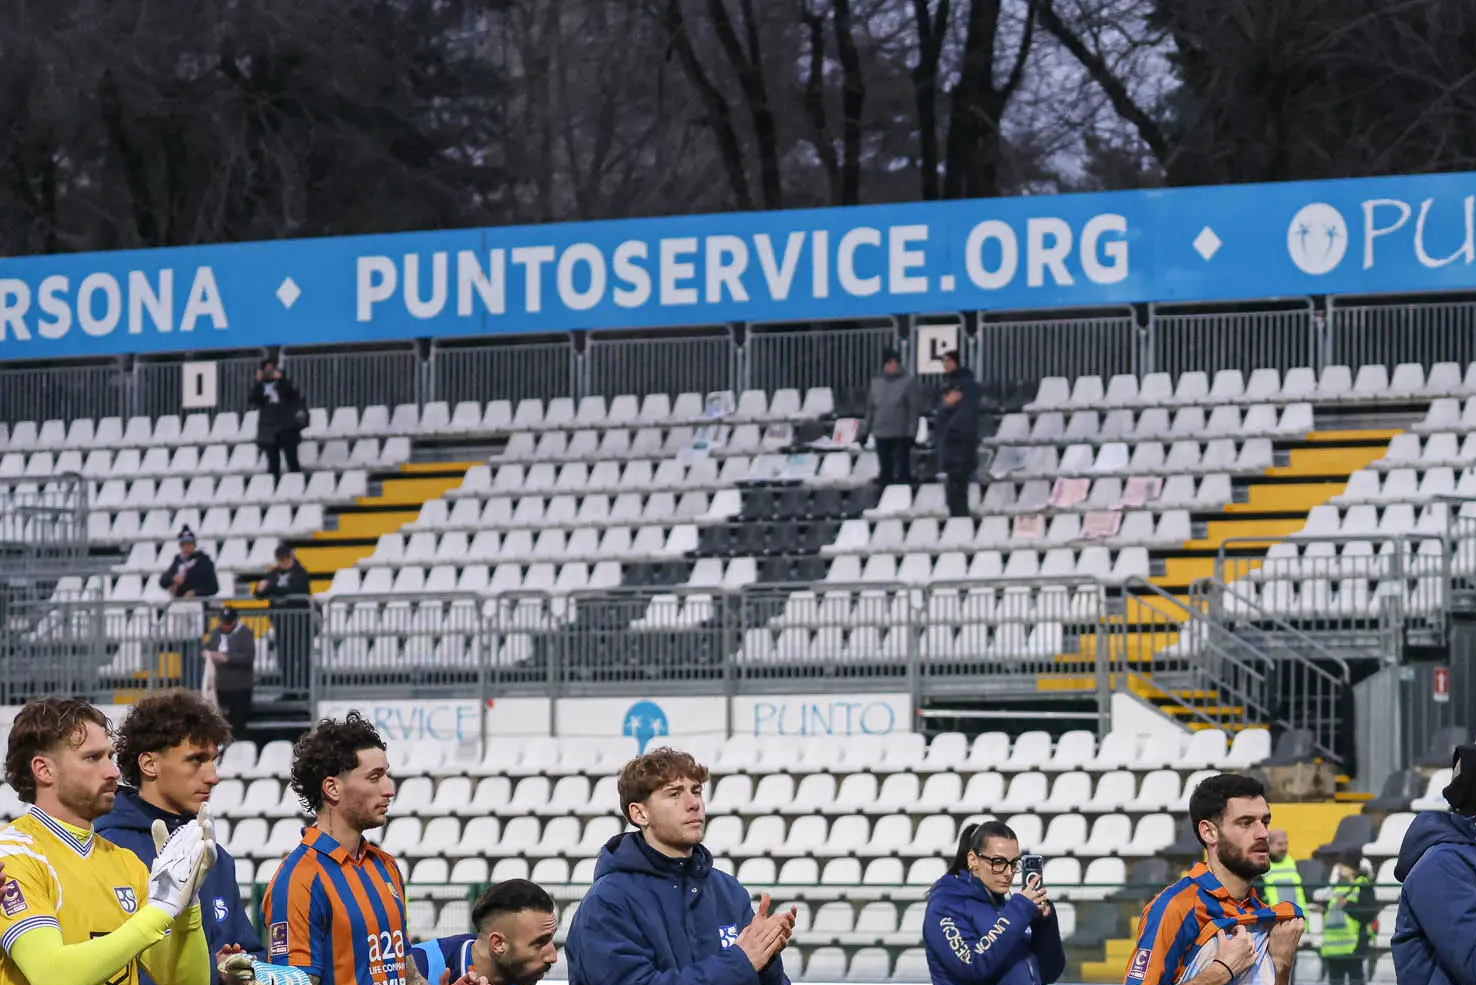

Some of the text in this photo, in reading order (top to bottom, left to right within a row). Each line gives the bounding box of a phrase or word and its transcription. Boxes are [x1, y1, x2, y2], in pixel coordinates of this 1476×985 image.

[357, 214, 1129, 321] PUNTOSERVICE.ORG
[0, 266, 229, 341] RSONA
[753, 701, 896, 738] PUNTO
[367, 929, 406, 963] a2a
